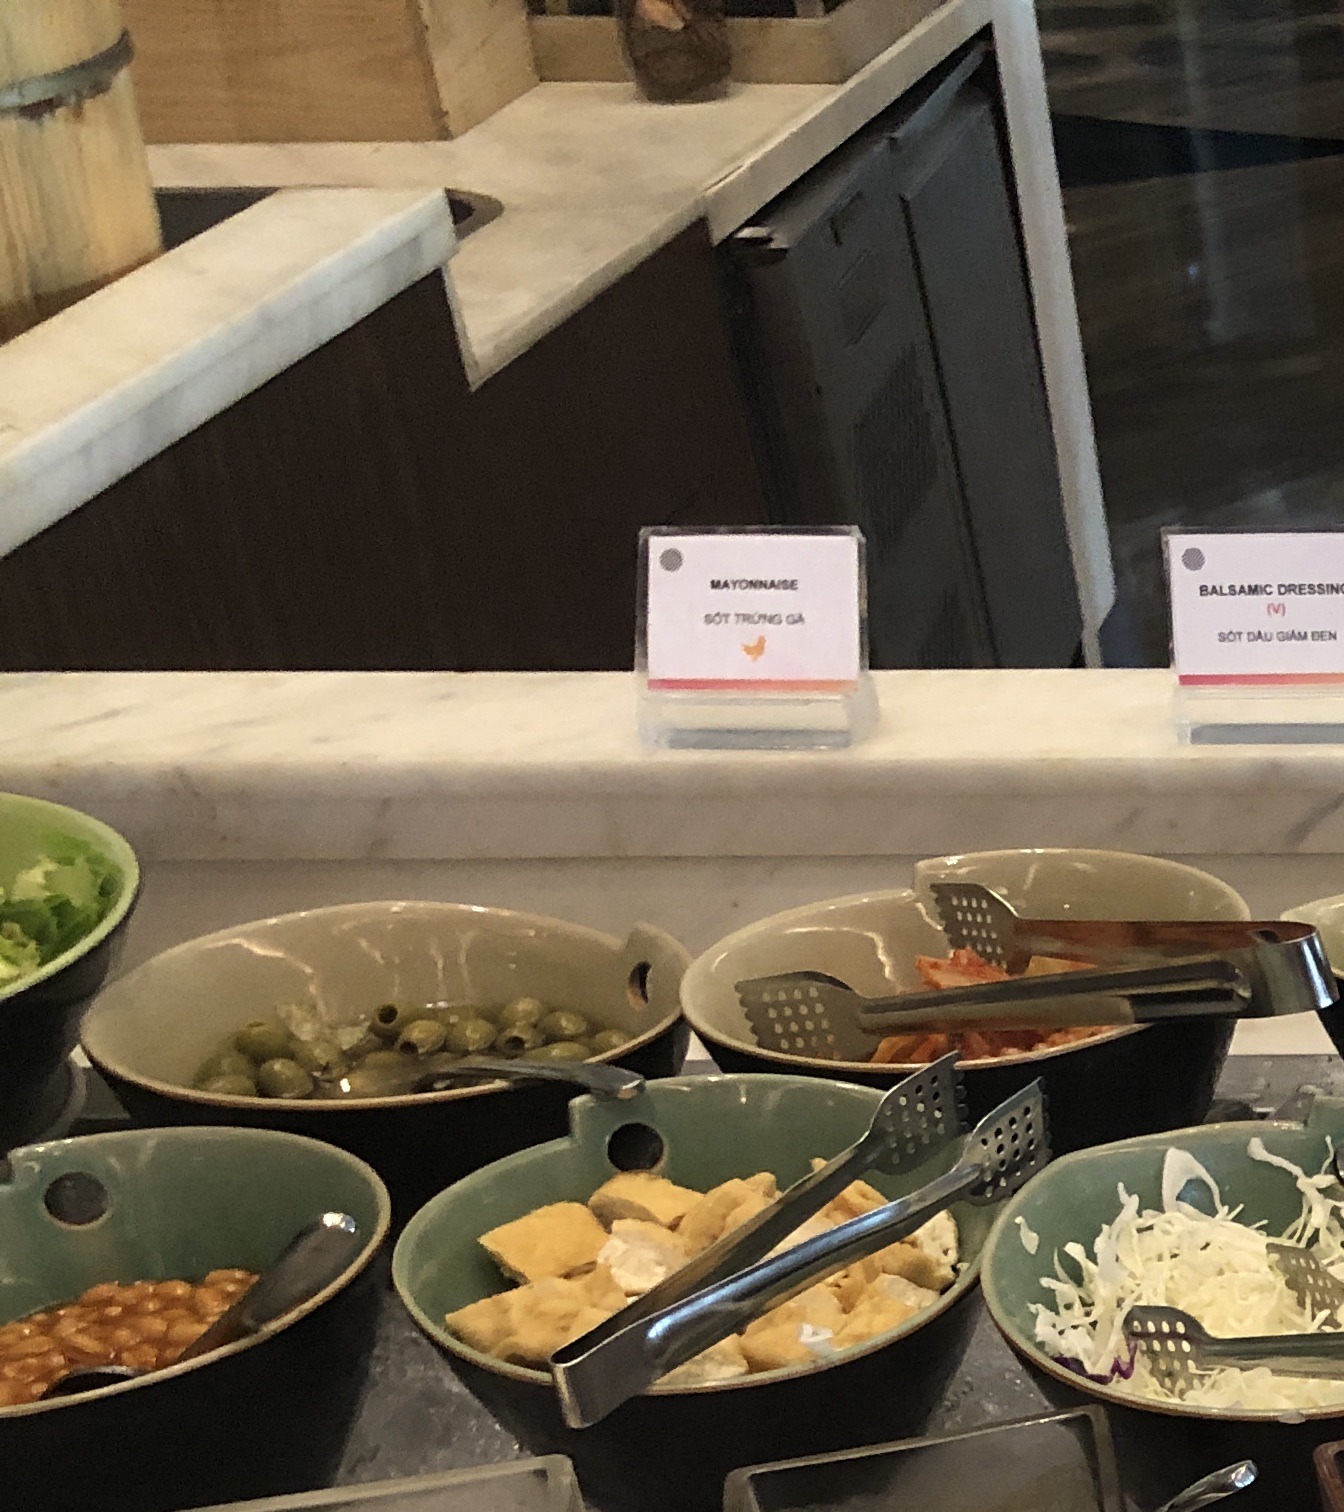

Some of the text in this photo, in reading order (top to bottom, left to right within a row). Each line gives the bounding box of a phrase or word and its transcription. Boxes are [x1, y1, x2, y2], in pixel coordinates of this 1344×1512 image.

[710, 579, 799, 591] MAYONNAISE
[1199, 584, 1273, 597] BALSAMIC
[1266, 603, 1287, 617] (V)
